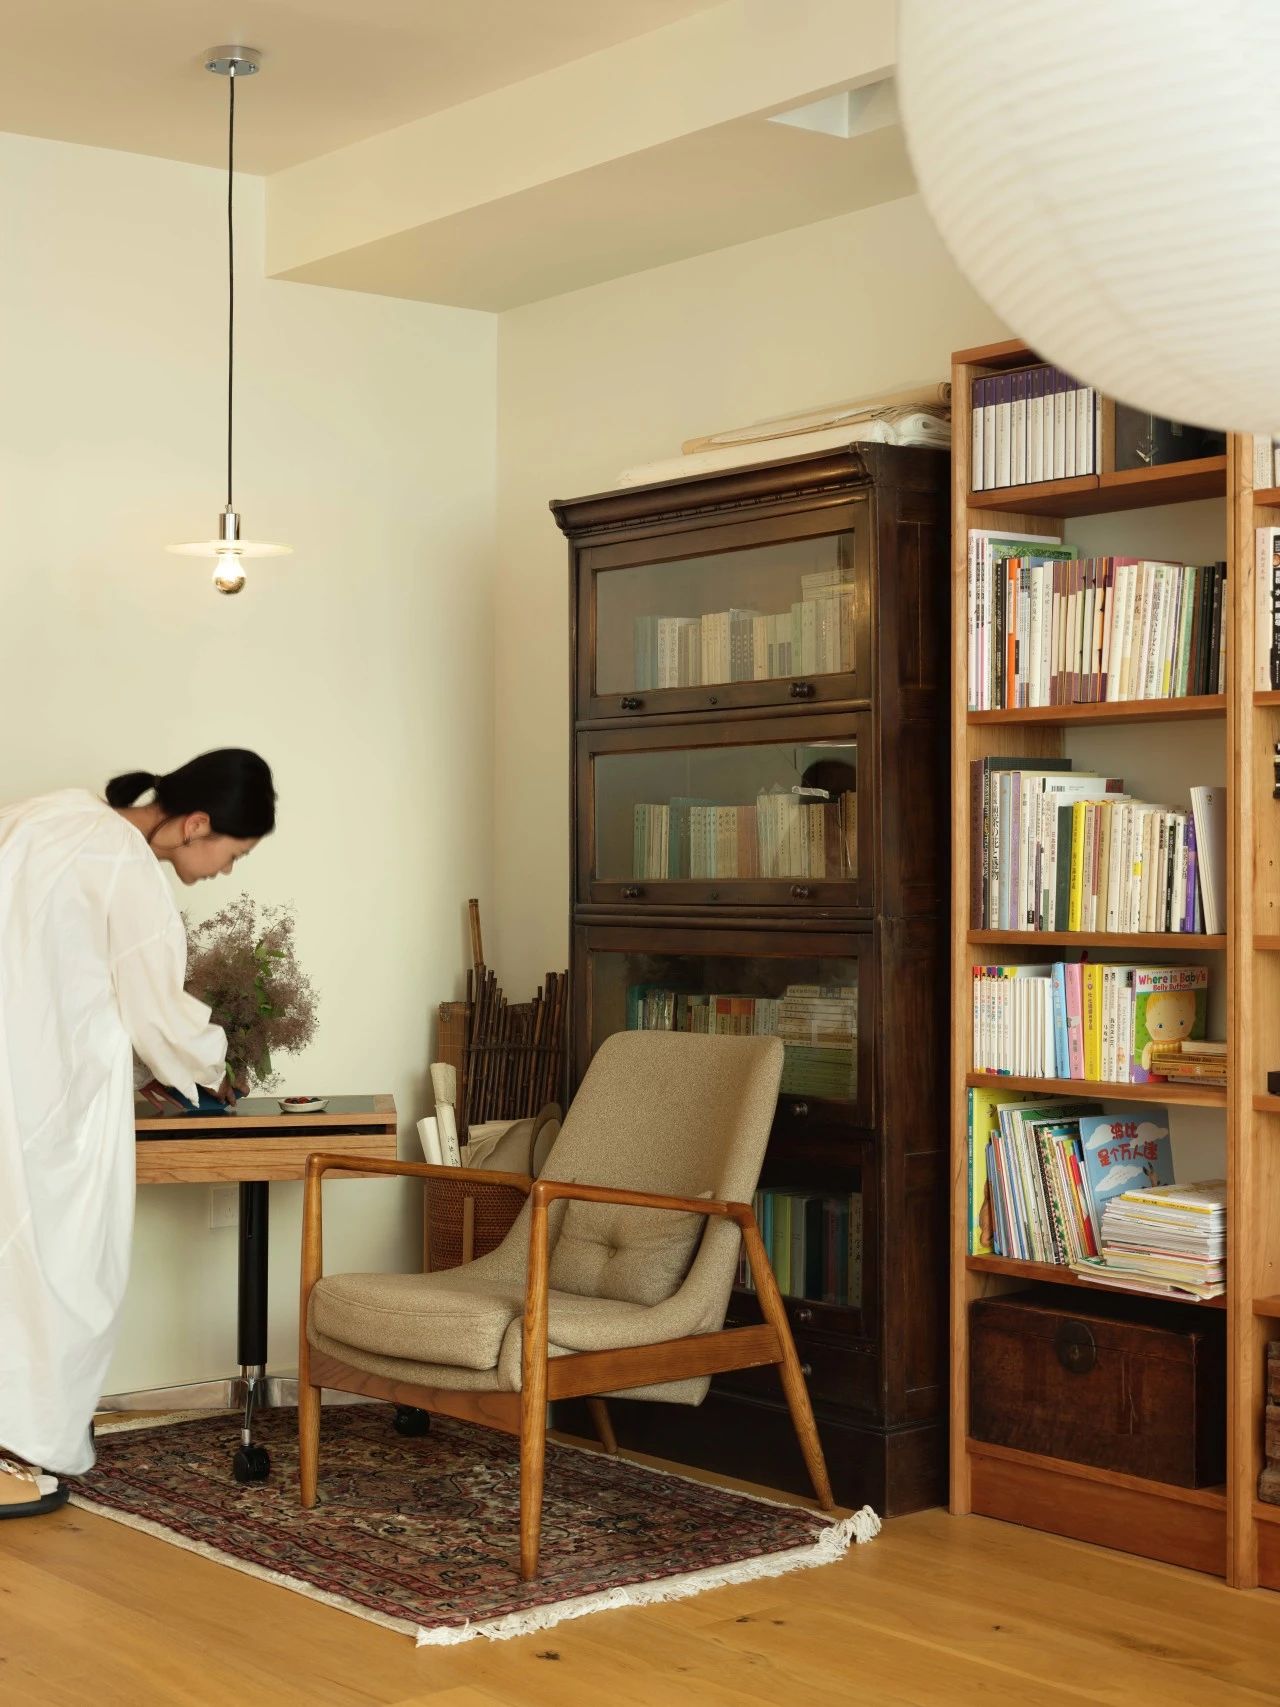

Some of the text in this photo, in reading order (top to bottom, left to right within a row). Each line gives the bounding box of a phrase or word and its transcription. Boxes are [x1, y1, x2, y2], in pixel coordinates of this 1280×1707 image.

[1138, 970, 1206, 984] Where is Baby's
[1110, 1121, 1138, 1139] 波比
[1097, 1140, 1158, 1168] 是个万人迷
